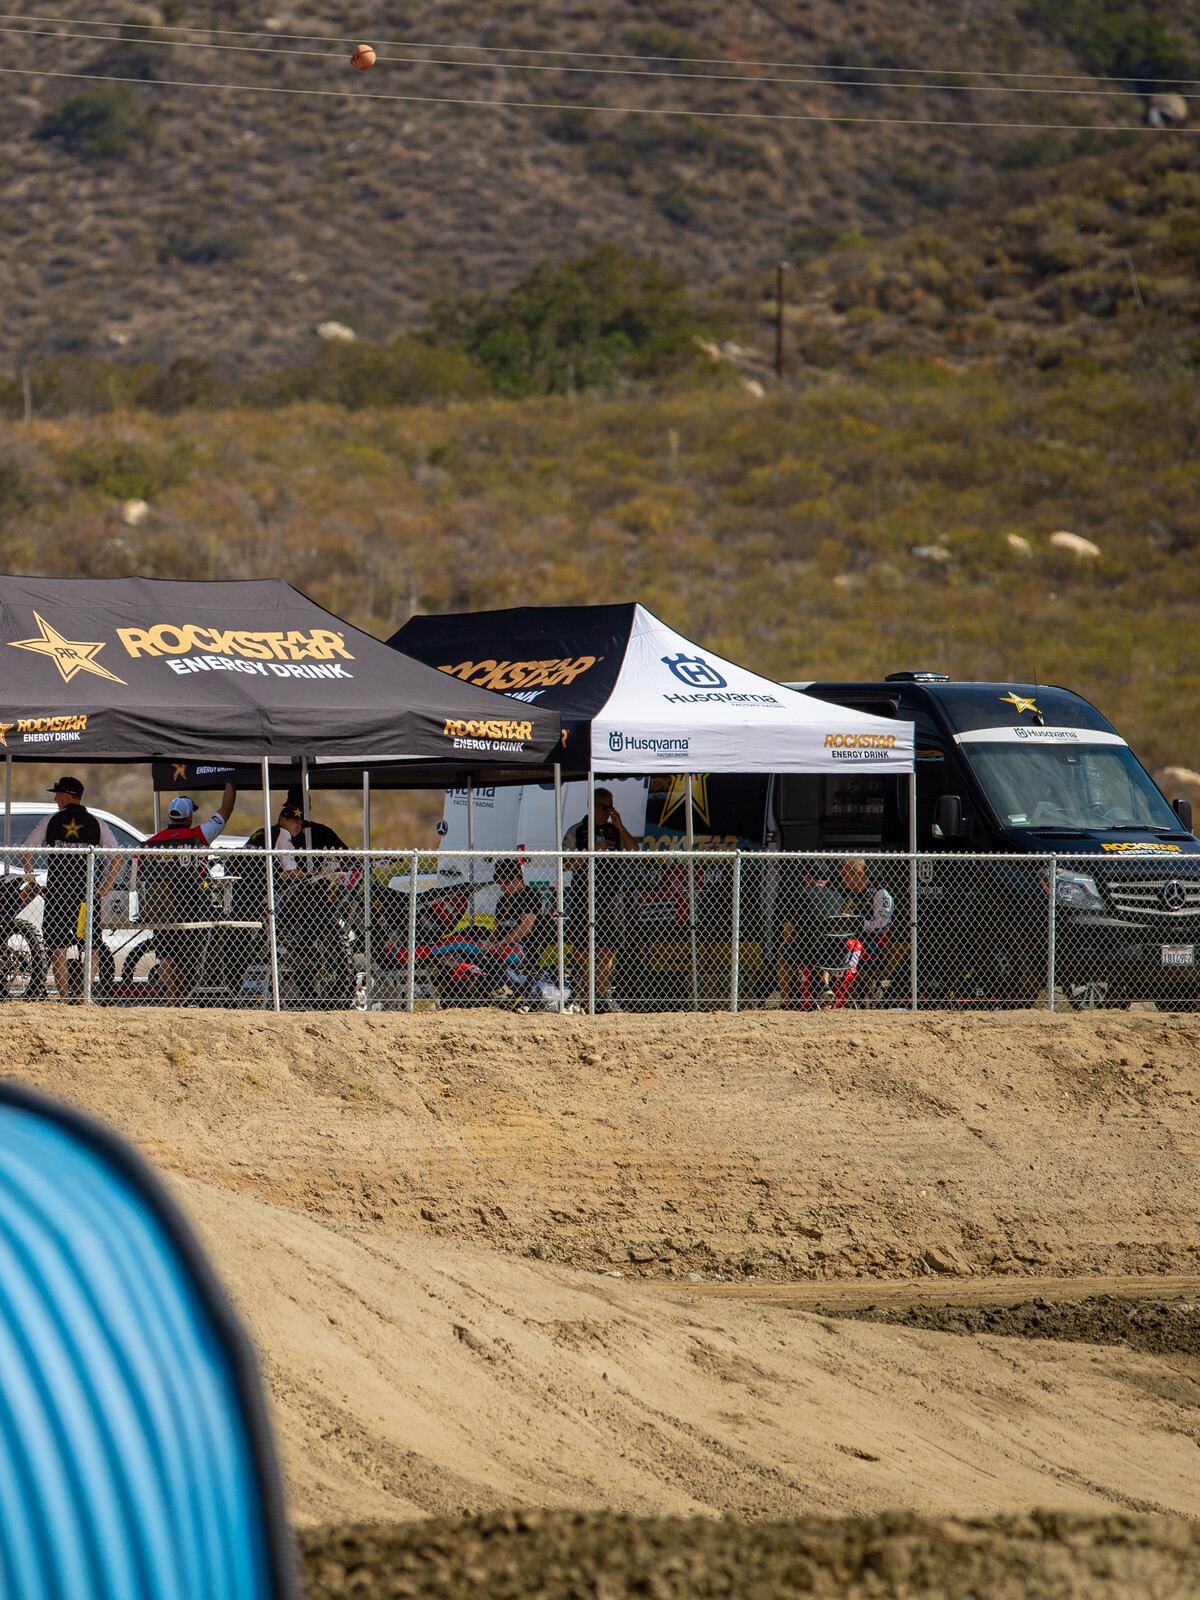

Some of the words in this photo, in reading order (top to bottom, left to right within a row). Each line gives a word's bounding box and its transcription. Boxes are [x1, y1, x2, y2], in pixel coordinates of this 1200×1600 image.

[116, 624, 355, 660] ROCKSTAR
[166, 655, 269, 675] ENERGY
[267, 663, 354, 679] DRINK
[662, 693, 779, 703] Husqvarna
[17, 715, 88, 732] ROCKSTAR
[443, 719, 532, 739] ROCKSTAR
[23, 733, 53, 742] ENERGY
[55, 732, 80, 741] DRINK
[1027, 729, 1077, 738] Husqvarna
[453, 738, 491, 751] ENERGY
[492, 740, 524, 752] DRINK
[625, 736, 688, 752] Husqvarna
[824, 734, 896, 749] ROCKSTAR
[1101, 843, 1182, 852] ROCKSTAR
